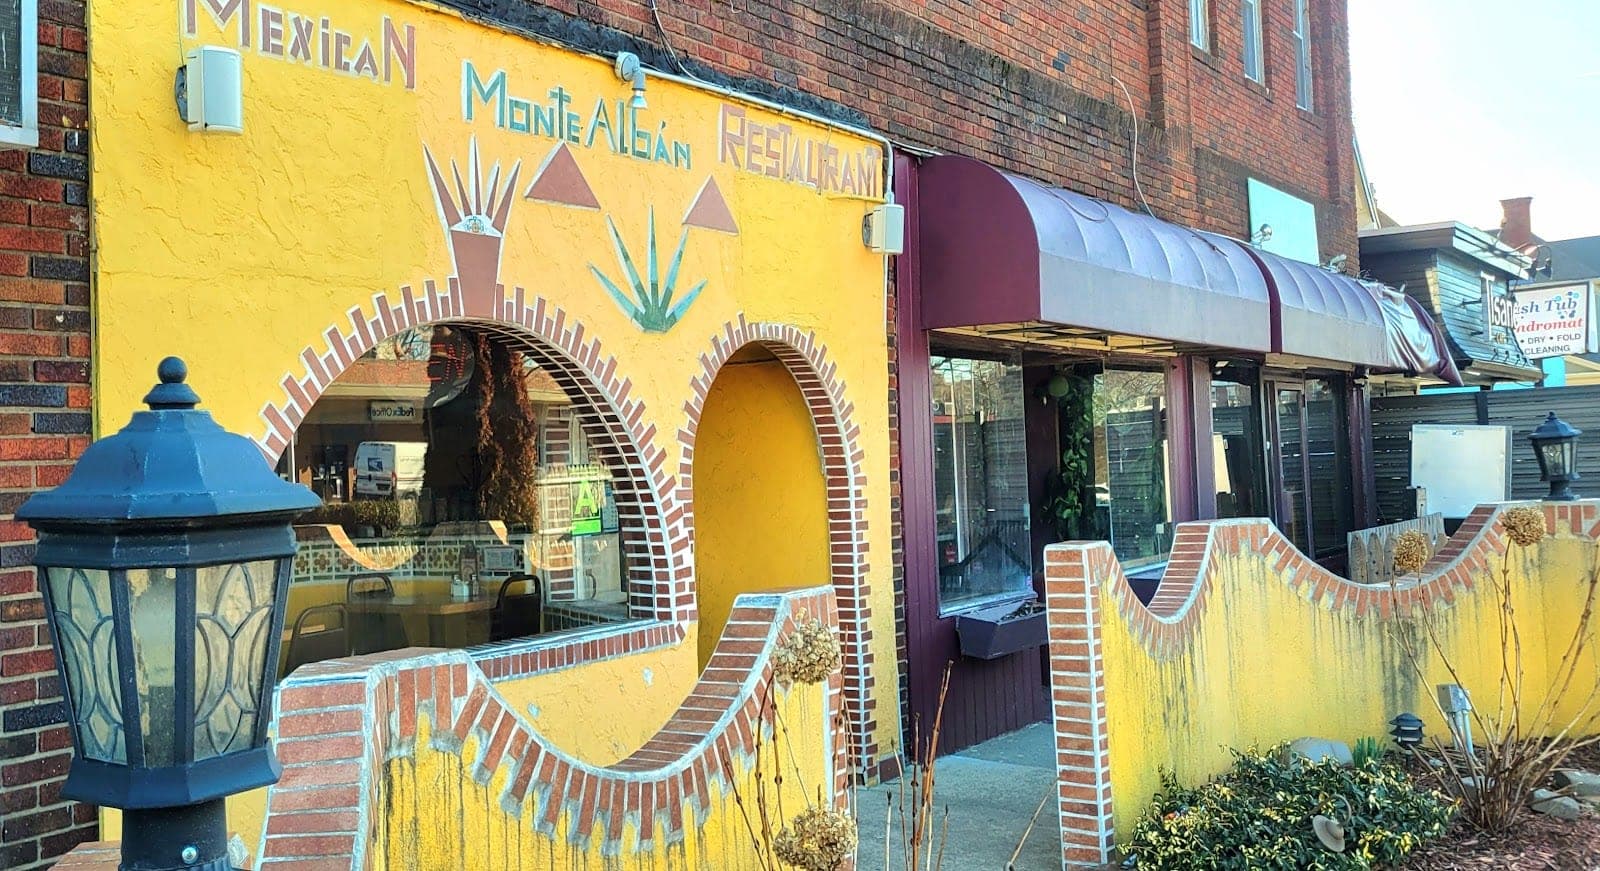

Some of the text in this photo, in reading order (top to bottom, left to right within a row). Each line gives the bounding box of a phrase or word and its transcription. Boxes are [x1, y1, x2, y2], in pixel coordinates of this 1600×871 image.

[719, 102, 881, 198] RESTAURANT
[1545, 297, 1577, 312] Tub
[1516, 318, 1583, 333] ndromat
[1527, 333, 1581, 345] DRY FOLD
[1524, 344, 1571, 356] CLEANING
[574, 479, 599, 515] A
